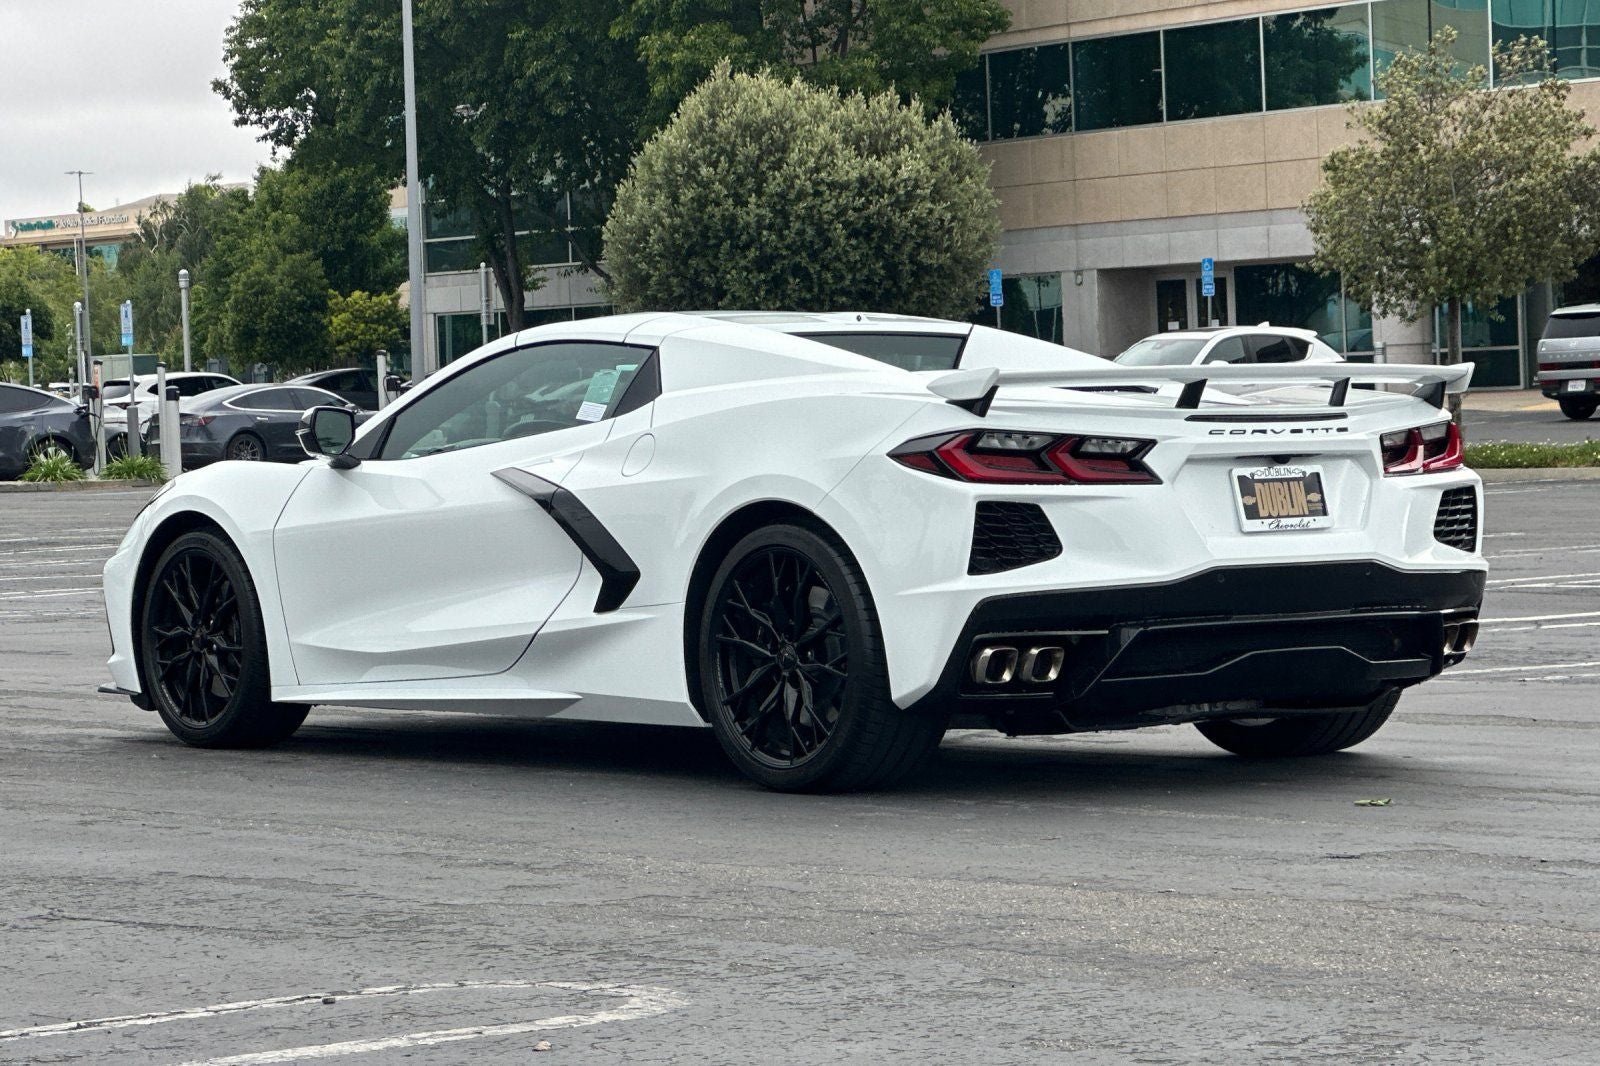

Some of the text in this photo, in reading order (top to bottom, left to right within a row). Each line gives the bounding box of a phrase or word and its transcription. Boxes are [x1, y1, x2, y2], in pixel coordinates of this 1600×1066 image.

[1208, 427, 1349, 435] CORVETTE
[1263, 468, 1292, 477] DUBLIN
[1254, 481, 1309, 517] DUBLIN
[1268, 518, 1311, 530] Chevrolet
